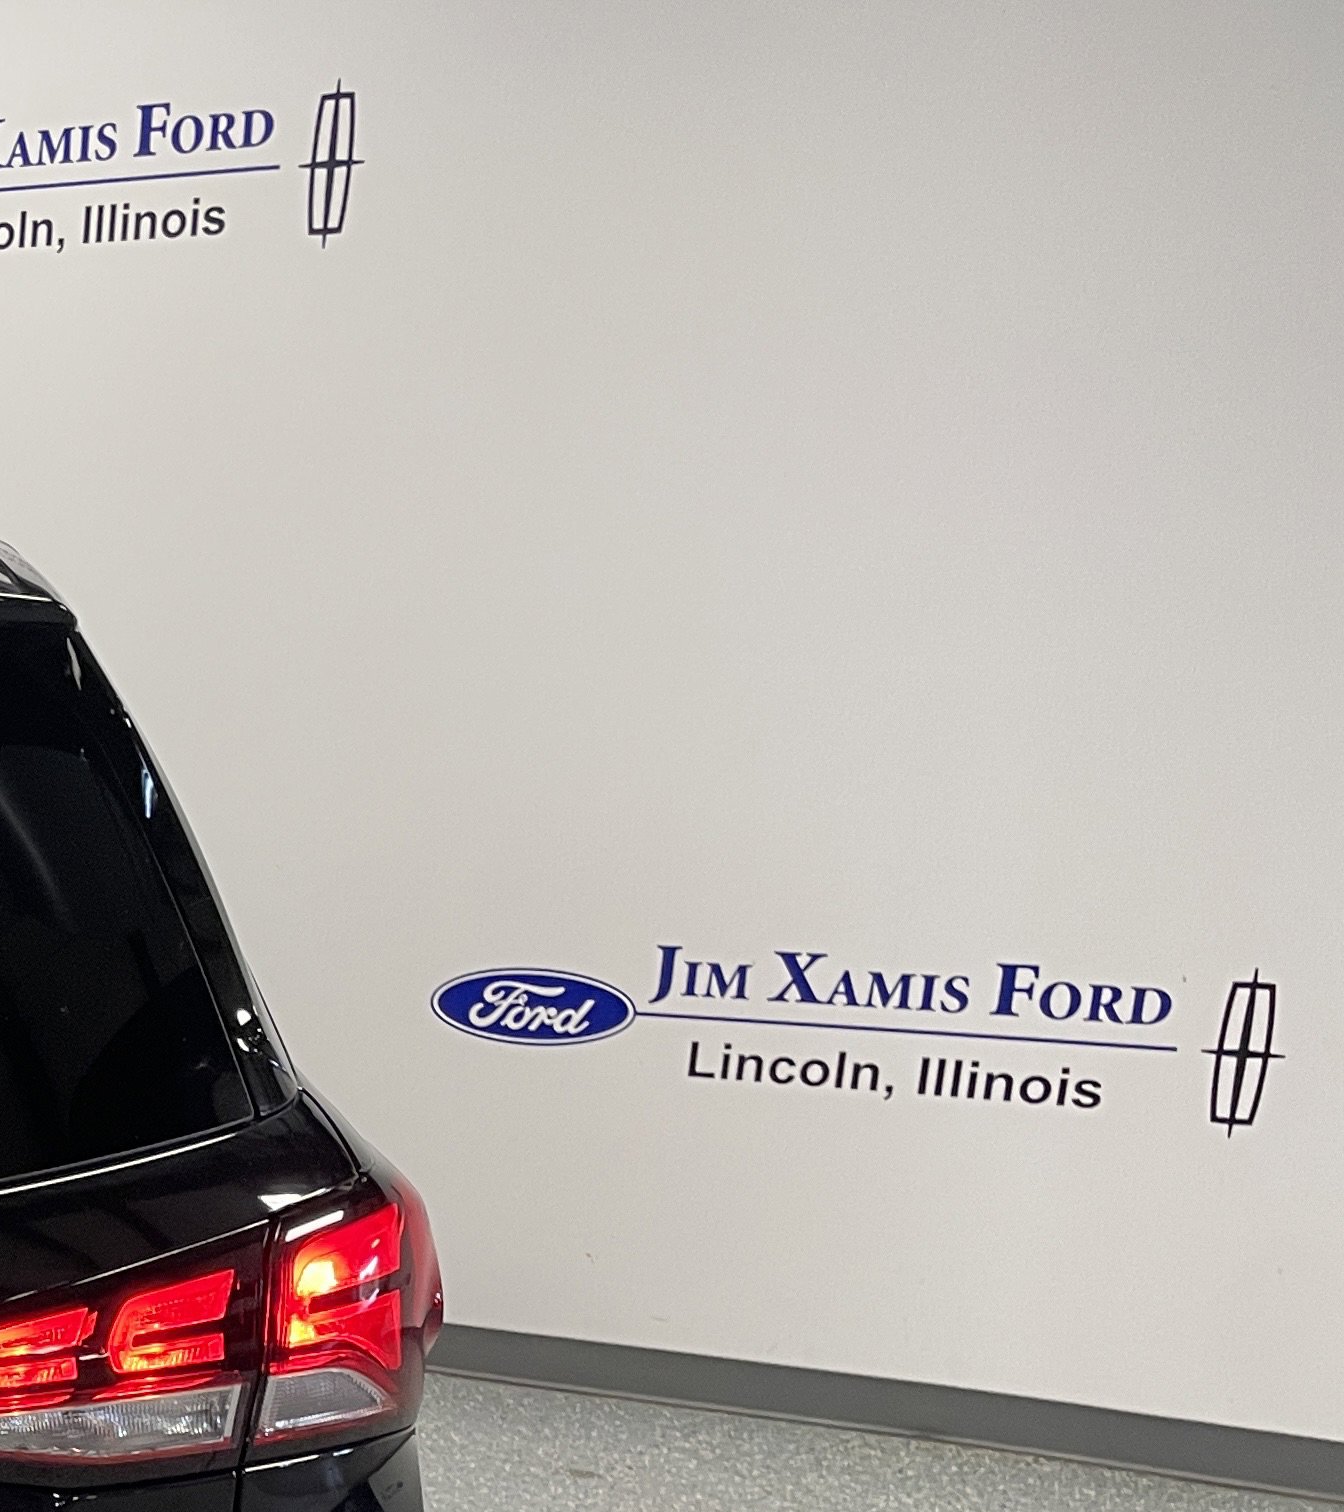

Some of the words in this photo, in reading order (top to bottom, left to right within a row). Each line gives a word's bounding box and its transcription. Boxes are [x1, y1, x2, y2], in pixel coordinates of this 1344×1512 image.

[132, 101, 276, 158] FORD
[81, 197, 226, 244] Illinois
[466, 980, 591, 1038] Ford
[647, 944, 753, 1005] JIM
[766, 951, 970, 1014] XAMIS
[989, 962, 1173, 1026] FORD
[686, 1041, 894, 1102] Lincoln,
[916, 1056, 1103, 1110] Illinois
